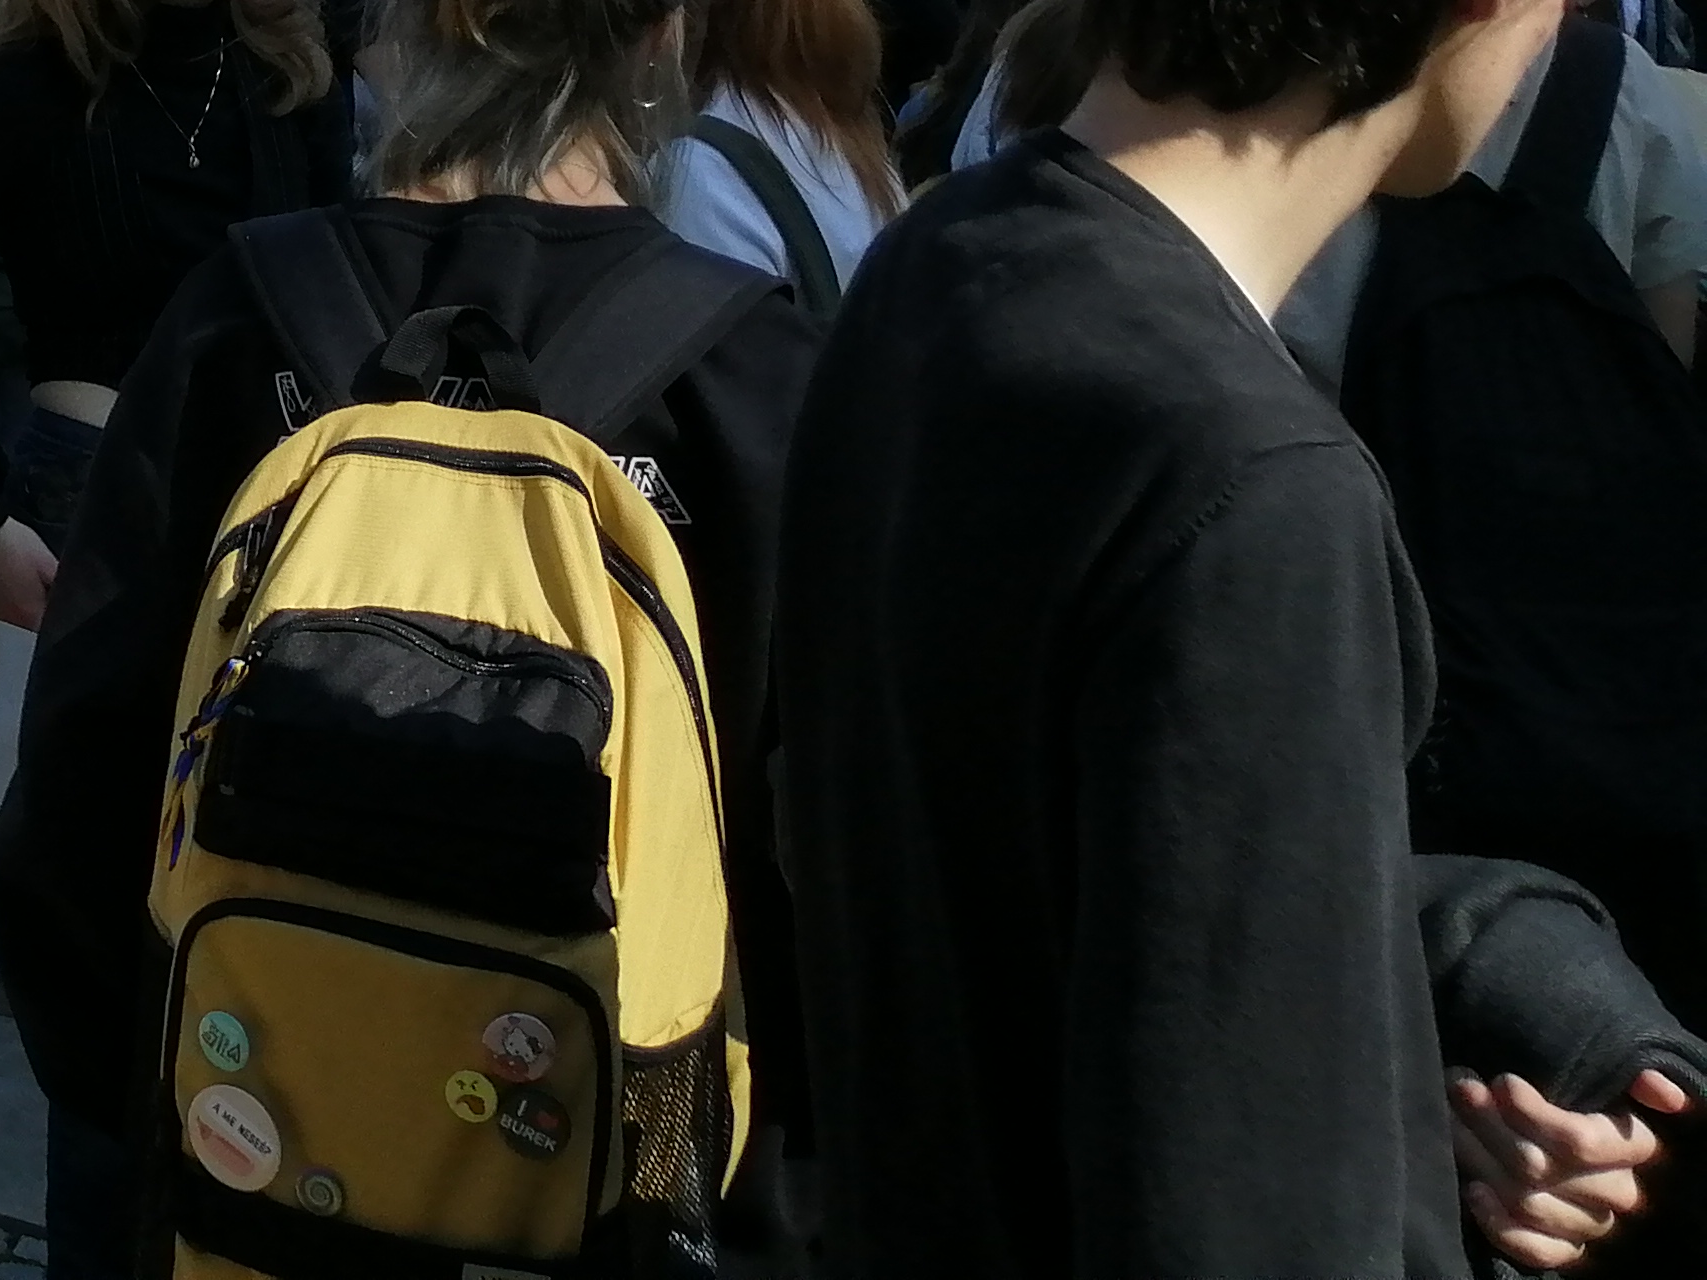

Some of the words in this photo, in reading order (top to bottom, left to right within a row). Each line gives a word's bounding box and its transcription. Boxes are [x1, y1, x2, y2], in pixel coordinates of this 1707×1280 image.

[212, 1103, 221, 1115] A
[221, 1109, 237, 1127] ME
[499, 1112, 557, 1152] BUREK
